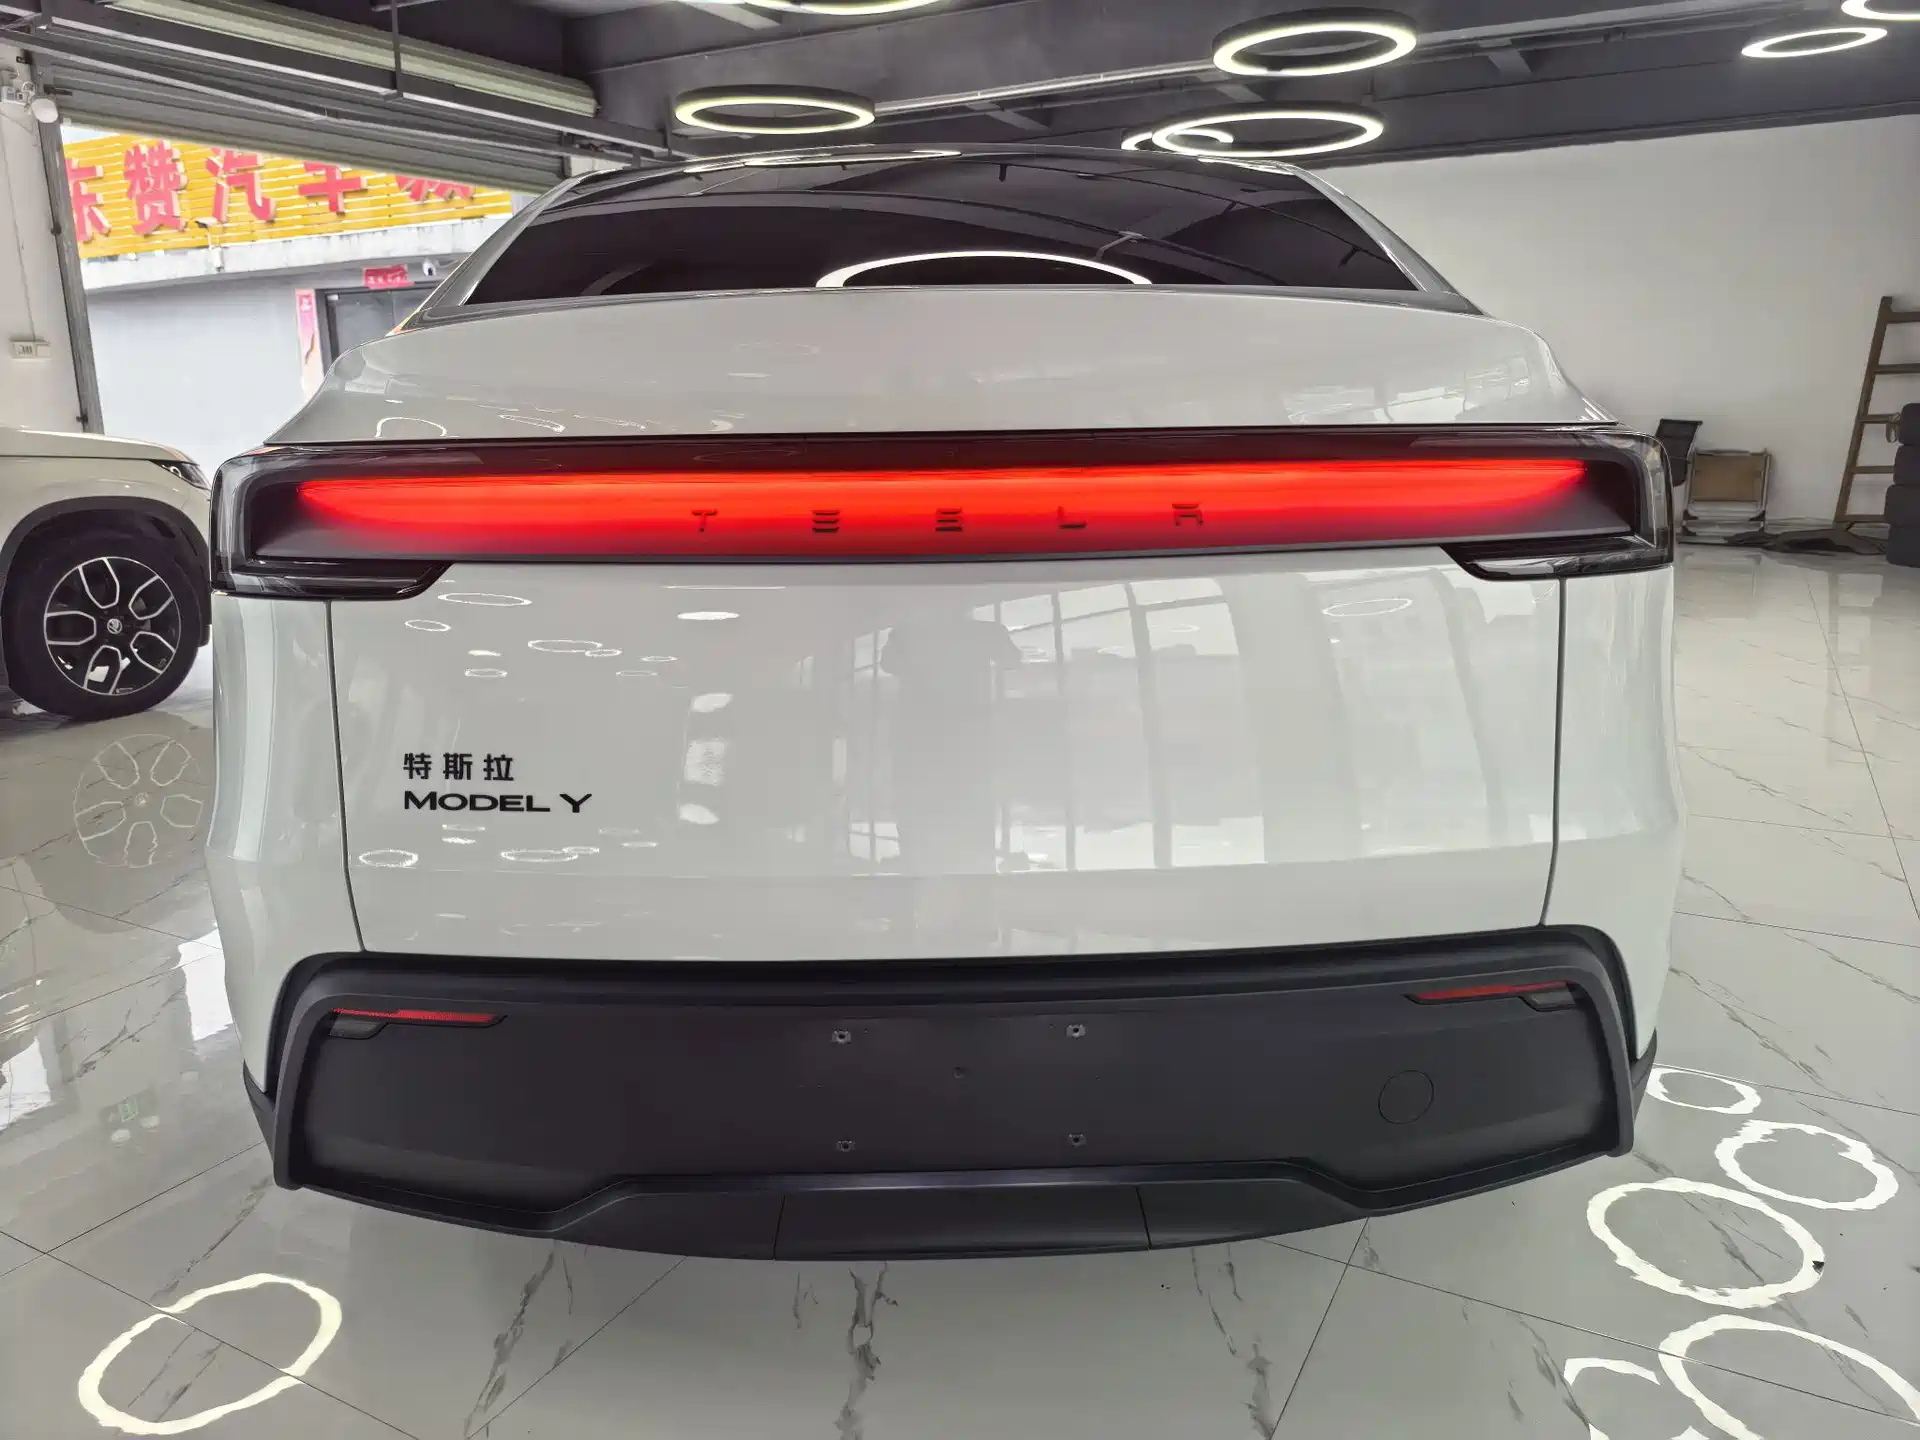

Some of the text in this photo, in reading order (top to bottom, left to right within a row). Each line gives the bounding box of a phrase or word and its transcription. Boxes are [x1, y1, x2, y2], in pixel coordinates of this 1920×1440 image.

[692, 503, 1204, 533] TESLA
[403, 753, 514, 781] 特斯拉
[404, 790, 592, 813] MODEL Y
